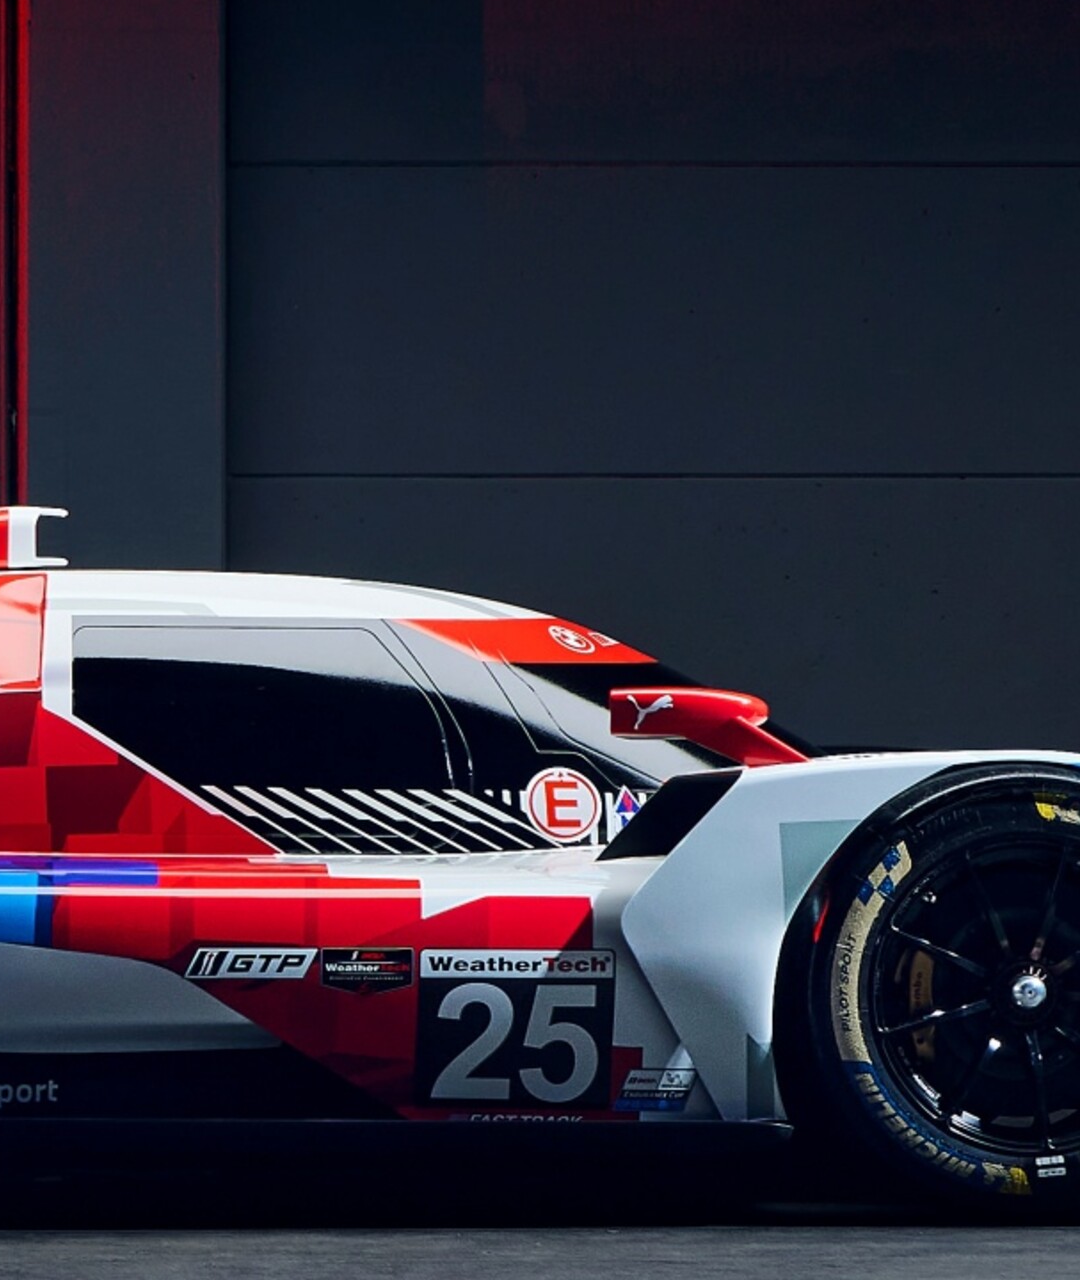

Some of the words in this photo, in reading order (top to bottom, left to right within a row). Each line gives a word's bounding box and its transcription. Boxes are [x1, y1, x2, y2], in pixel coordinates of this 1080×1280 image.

[544, 780, 581, 828] E
[226, 954, 308, 973] GTP
[324, 963, 410, 972] WeatherTech
[430, 982, 599, 1103] 25
[853, 1071, 977, 1180] MICHELIN
